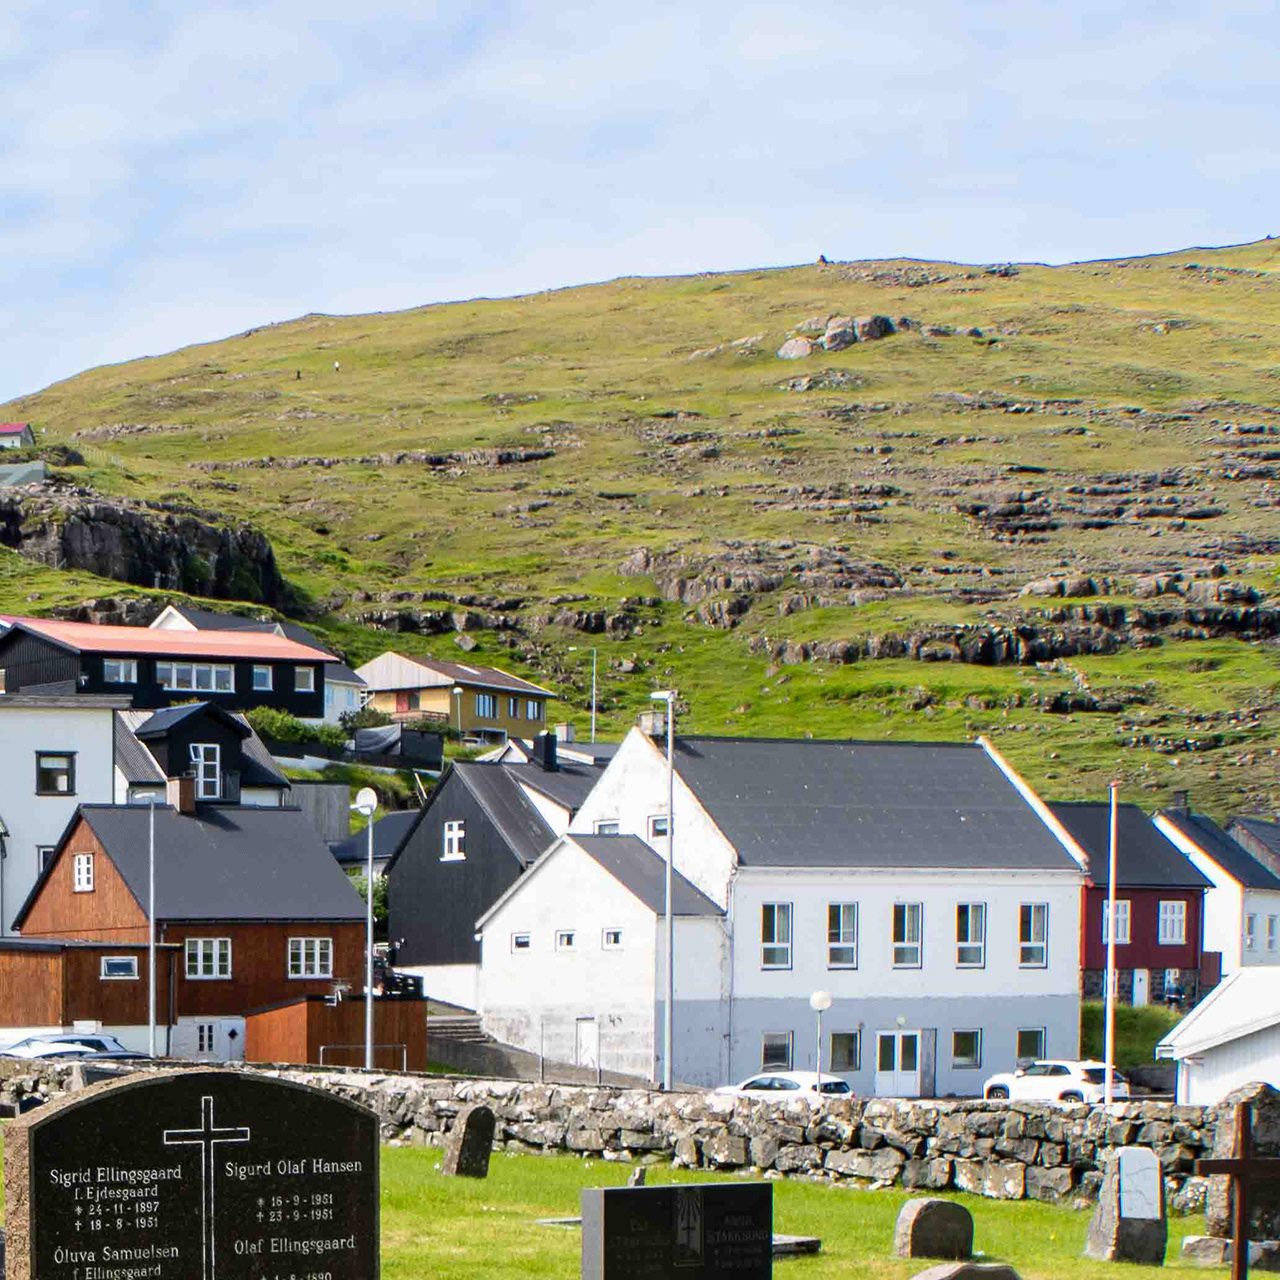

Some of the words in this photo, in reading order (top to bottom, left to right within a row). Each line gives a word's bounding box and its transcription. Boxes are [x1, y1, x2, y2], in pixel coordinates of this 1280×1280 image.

[50, 1167, 91, 1187] Sigrid
[97, 1165, 182, 1184] Ellingsgaard
[225, 1161, 271, 1180] Sigurd
[277, 1160, 306, 1174] Olaf
[313, 1158, 362, 1173] Hansen
[87, 1185, 159, 1202] Ejdesgaard
[103, 1245, 179, 1261] Samuelsen
[235, 1239, 264, 1254] Olaf
[271, 1235, 356, 1254] Ellingsgaard
[85, 1264, 161, 1280] Ellingsgaard
